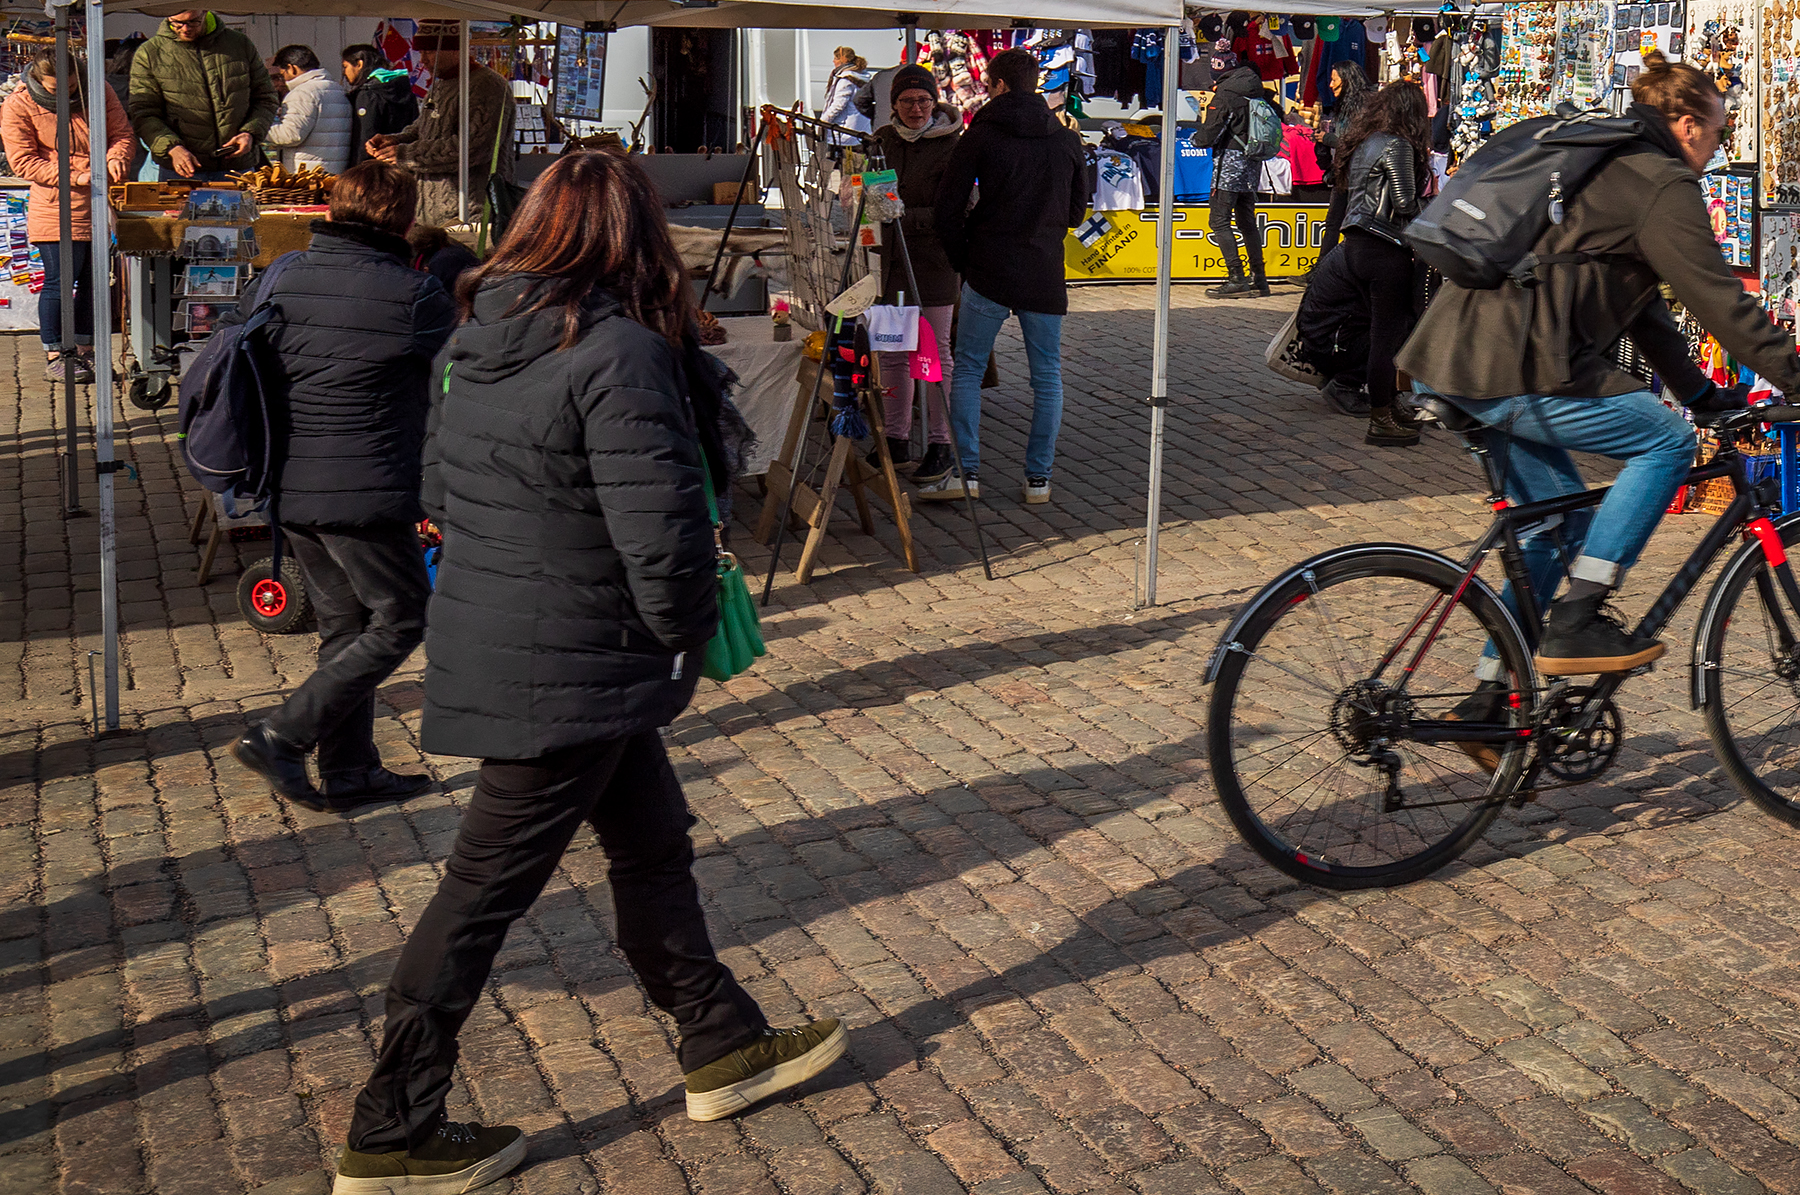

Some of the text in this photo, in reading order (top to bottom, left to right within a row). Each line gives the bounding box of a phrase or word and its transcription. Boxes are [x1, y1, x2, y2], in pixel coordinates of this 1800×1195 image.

[1180, 148, 1208, 157] SUOMI
[1081, 223, 1132, 266] Hand printed in
[1087, 230, 1139, 274] FINLAND
[1279, 253, 1291, 267] 2
[1142, 266, 1157, 274] COT
[875, 333, 903, 343] SUOMI
